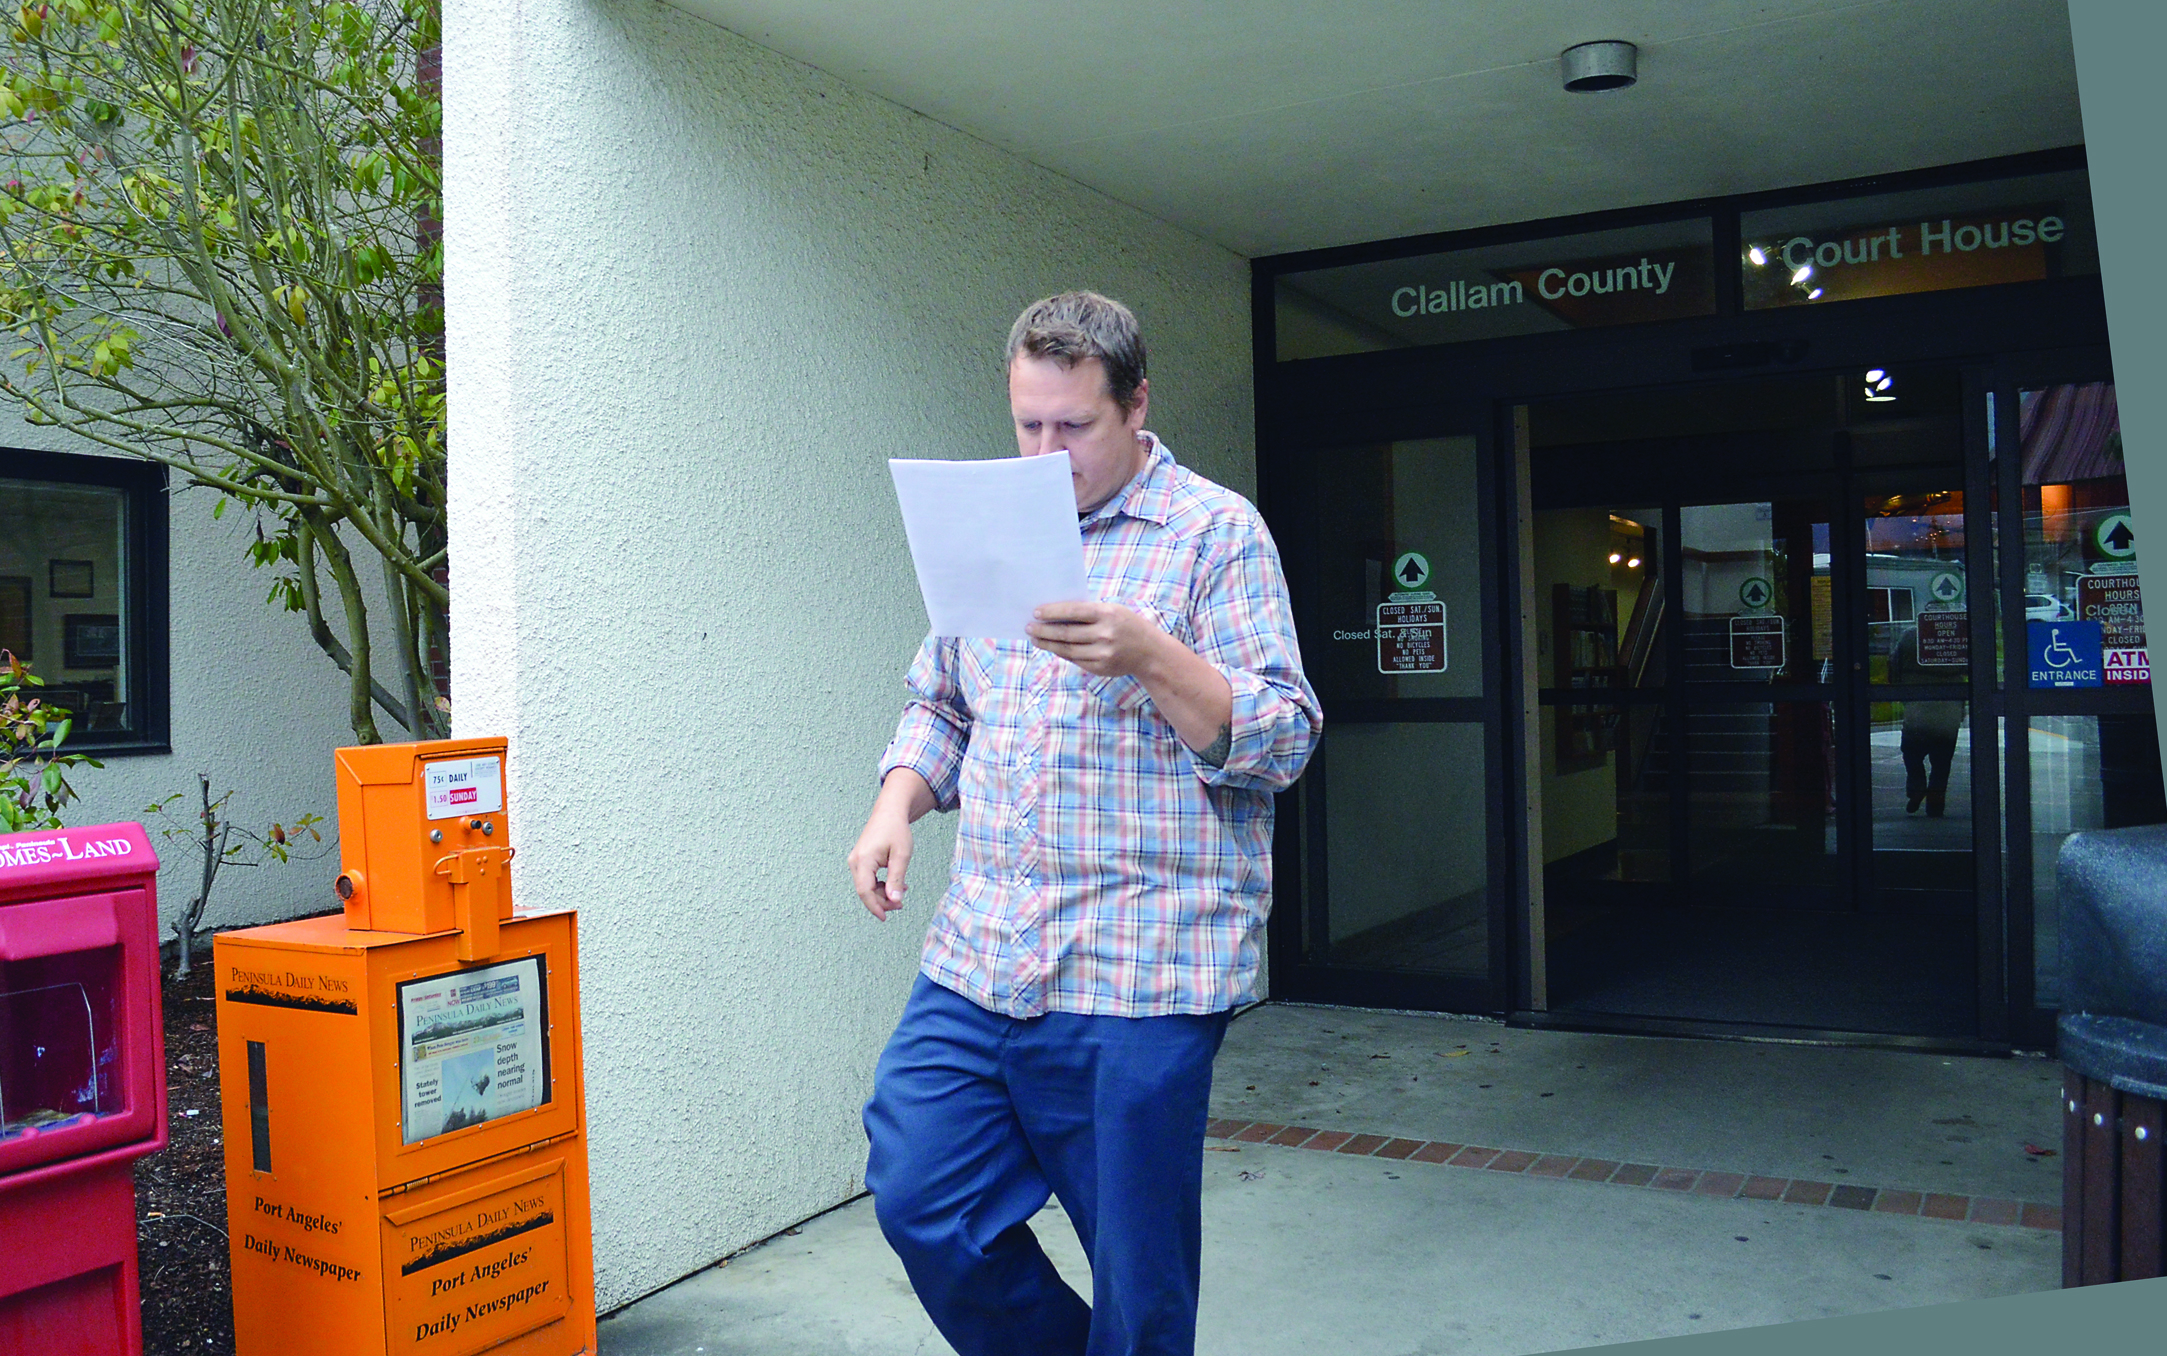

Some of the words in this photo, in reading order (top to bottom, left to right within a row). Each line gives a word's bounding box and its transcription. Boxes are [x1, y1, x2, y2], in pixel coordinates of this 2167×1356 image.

[1783, 226, 1902, 271] Court
[1920, 216, 2064, 255] House
[1391, 280, 1523, 317] Clallam
[1538, 258, 1675, 300] County
[2105, 589, 2140, 601] HOURS
[1383, 606, 1406, 615] CLOSED
[1923, 613, 1968, 621] COURTHOUSE
[1397, 614, 1428, 623] HOLIDAYS
[1935, 621, 1957, 629] HOURS
[1333, 629, 1371, 640] Closed
[1374, 629, 1396, 639] Sat.
[1410, 628, 1432, 638] Sun
[2108, 636, 2140, 644] CLOSED
[1393, 655, 1416, 663] ALLOWED
[2031, 670, 2096, 681] ENTRANCE
[448, 773, 467, 783] DAILY
[450, 791, 477, 803] SUNDAY
[232, 967, 282, 986] PENINSULA
[286, 972, 314, 989] DAILY
[318, 976, 348, 993] NEWS
[416, 1008, 463, 1026] PENINSULA
[466, 1001, 492, 1015] DAILY
[494, 996, 519, 1009] NEWS
[496, 1041, 518, 1054] Snow
[497, 1052, 518, 1066] depth
[497, 1062, 525, 1077] nearing
[416, 1078, 439, 1090] Stately
[497, 1075, 523, 1089] normal
[418, 1088, 437, 1098] tower
[414, 1095, 442, 1108] removed
[255, 1196, 282, 1218] Port
[286, 1206, 342, 1234] Angeles'
[410, 1221, 473, 1252] PENINSULA
[477, 1207, 509, 1228] DAILY
[514, 1196, 545, 1216] NEWS
[244, 1234, 280, 1262] Daily
[284, 1246, 361, 1281] Newspaper
[431, 1271, 466, 1297] Port
[470, 1246, 532, 1282] Angeles'
[415, 1313, 460, 1342] Daily
[465, 1280, 549, 1323] Newspaper
